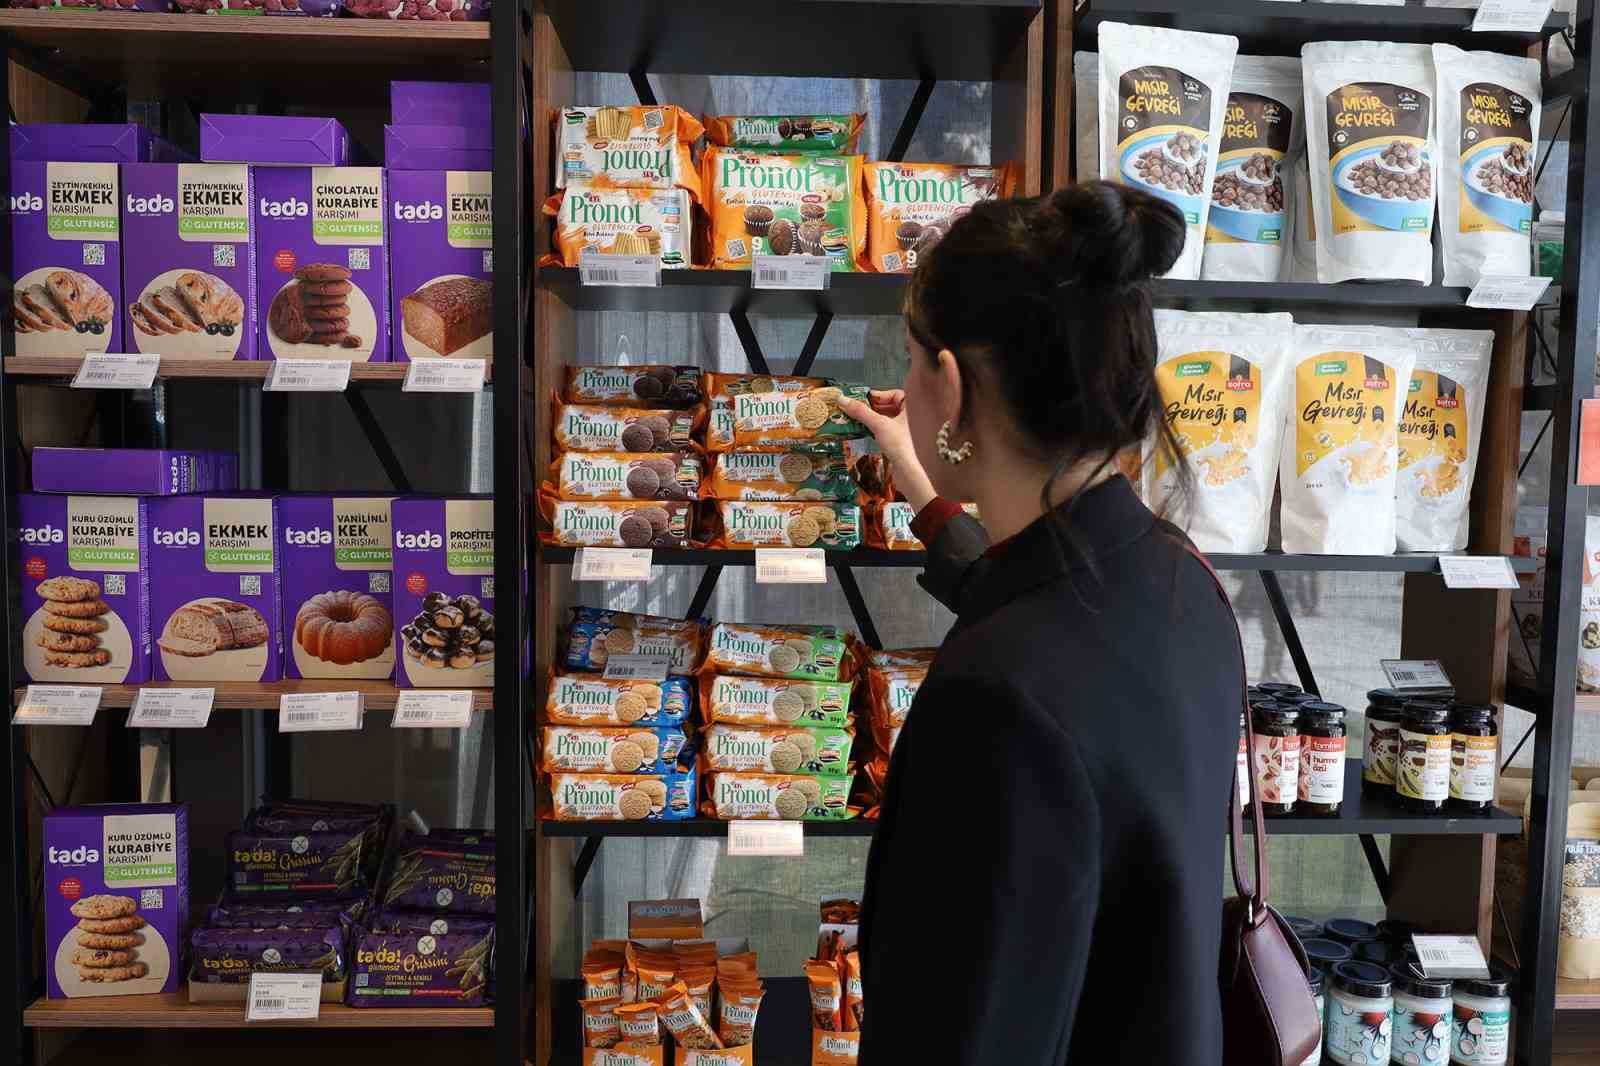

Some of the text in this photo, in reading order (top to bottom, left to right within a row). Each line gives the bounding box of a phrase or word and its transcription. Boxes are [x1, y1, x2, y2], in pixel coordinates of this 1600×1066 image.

[1135, 79, 1169, 95] MISIR
[1342, 95, 1383, 111] MISIR
[1471, 94, 1499, 109] MISIR
[1225, 107, 1247, 122] SIR
[601, 150, 672, 177] Pronot
[722, 158, 812, 192] Pronot
[316, 184, 378, 196] ÇİKOLATALI
[879, 168, 966, 202] Pronot
[11, 192, 43, 211] da
[52, 191, 113, 204] EKMEK
[127, 194, 174, 213] tada
[183, 192, 243, 205] EKMEK
[317, 196, 378, 209] KURABİYE
[451, 198, 489, 211] EKM
[52, 205, 94, 215] KARIŞIMI
[183, 206, 224, 216] KARIŞIMI
[260, 197, 309, 217] tada
[317, 210, 359, 220] KARIŞIMI
[394, 201, 443, 220] tada
[570, 195, 642, 224] Pronot
[451, 212, 491, 223] KARIŞIM
[328, 223, 379, 233] GLUTENSİZ
[583, 370, 630, 387] Pronot
[1184, 383, 1224, 404] Mısır
[1325, 381, 1363, 402] Mısır
[740, 398, 790, 417] Pronot
[1167, 401, 1229, 426] Gevreği
[1302, 400, 1367, 424] Gevreği
[1402, 400, 1435, 419] Mısır
[569, 415, 618, 436] Pronot
[1398, 419, 1439, 440] evreği
[570, 461, 623, 481] Pronot
[71, 514, 134, 524] KURU ÜZÜMLÜ
[564, 509, 615, 530] Pronot
[732, 508, 784, 529] Pronot
[72, 525, 134, 537] KURABİYE
[153, 527, 201, 545] tada
[209, 525, 268, 537] EKMEK
[285, 527, 332, 545] tada
[338, 525, 368, 536] KEK
[396, 530, 442, 549] tada
[72, 537, 115, 547] KARIŞIMI
[209, 539, 250, 549] KARIŞIMI
[339, 537, 379, 547] KARIŞIMI
[450, 541, 491, 550] KARIŞIMI
[84, 551, 135, 560] GLUTENSİZ
[220, 553, 271, 561] GLUTENSİZ
[717, 631, 767, 654] Pronot
[561, 684, 611, 705] Pronot
[719, 684, 768, 704] Pronot
[556, 735, 608, 755] Pronot
[716, 735, 767, 756] Pronot
[565, 783, 615, 804] Pronot
[721, 783, 770, 804] Pronot
[108, 832, 171, 842] KURU ÜZÜMLÜ
[48, 845, 99, 864] tada
[108, 842, 172, 854] KURABİYE
[108, 854, 151, 864] KARIŞIMI
[120, 866, 173, 876] GLUTENSİZ
[403, 952, 448, 973] Grissini
